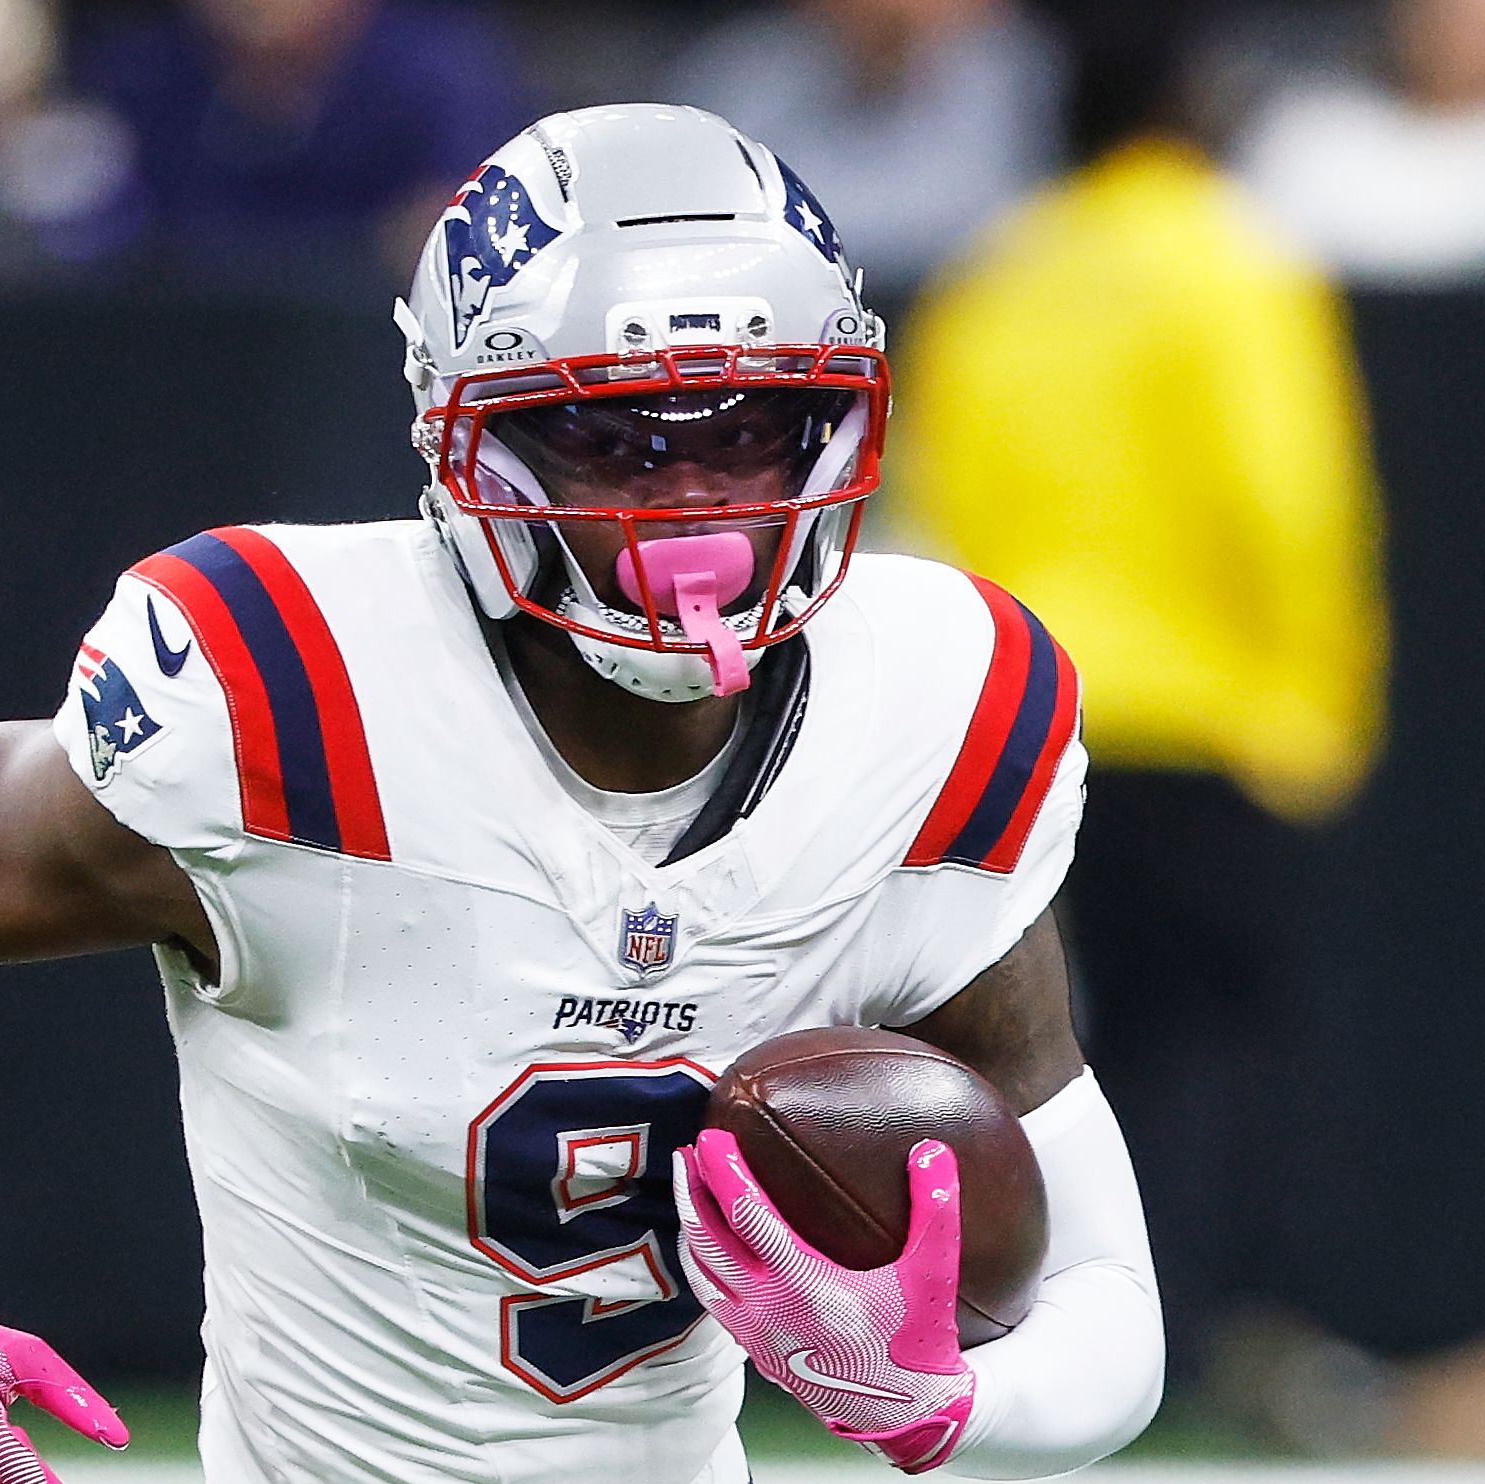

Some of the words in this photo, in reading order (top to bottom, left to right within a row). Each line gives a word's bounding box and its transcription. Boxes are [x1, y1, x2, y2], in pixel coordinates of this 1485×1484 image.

[477, 350, 536, 364] OAKLEY
[626, 935, 667, 963] NFL
[552, 998, 698, 1032] PATRIOTS
[467, 1057, 719, 1404] 9
